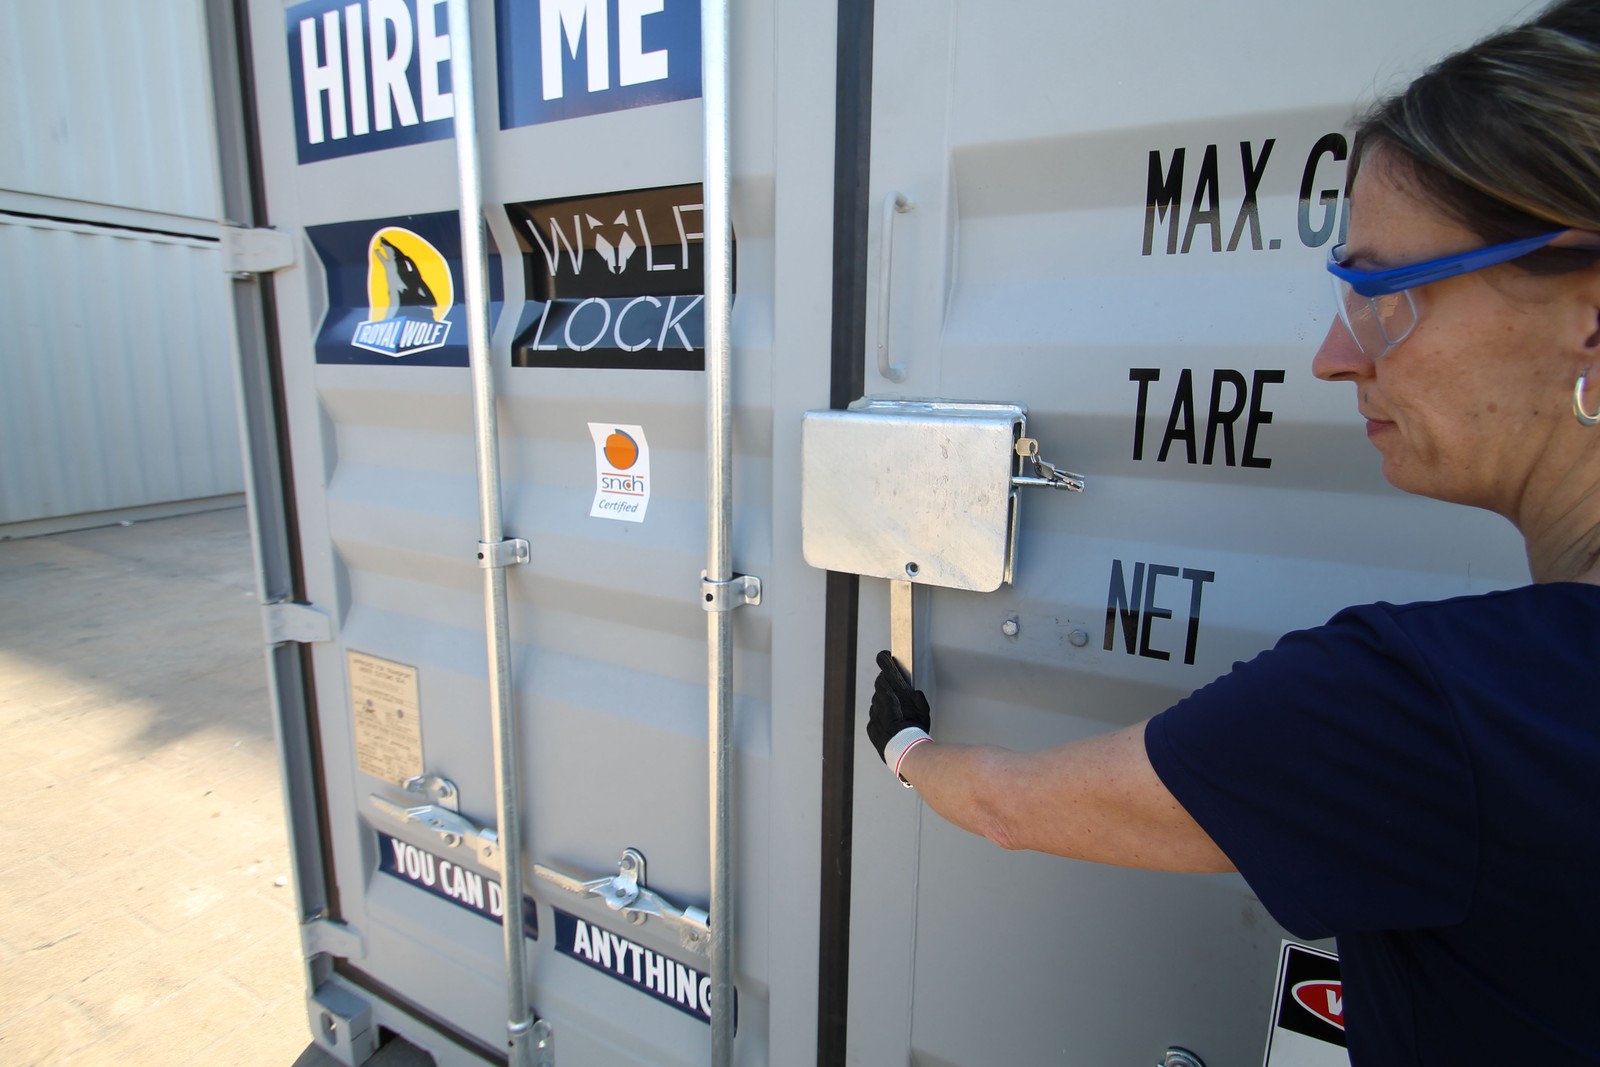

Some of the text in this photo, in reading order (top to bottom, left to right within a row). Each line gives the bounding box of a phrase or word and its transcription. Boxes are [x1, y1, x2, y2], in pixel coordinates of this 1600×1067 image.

[300, 0, 453, 144] HIRE
[541, 0, 668, 101] ME
[359, 320, 443, 349] ROYAL WOLF
[532, 295, 704, 352] LOCK
[1129, 368, 1285, 469] TARE
[598, 499, 639, 513] Certified
[1103, 559, 1215, 665] NET
[391, 838, 436, 886] YOU
[439, 861, 485, 909] CAN
[573, 919, 712, 1017] ANYTHING
